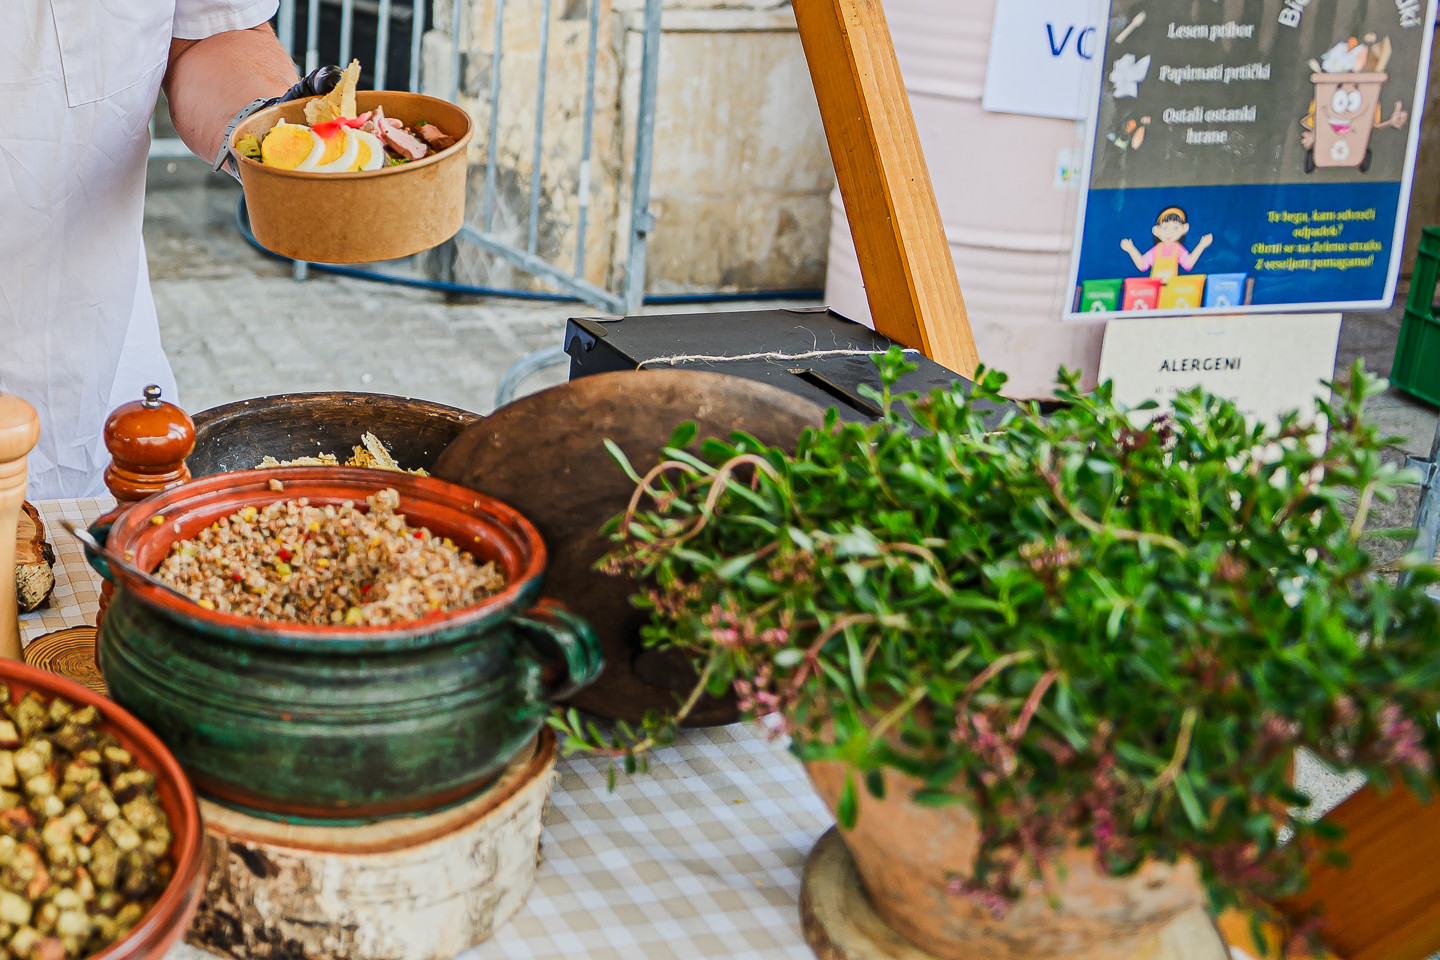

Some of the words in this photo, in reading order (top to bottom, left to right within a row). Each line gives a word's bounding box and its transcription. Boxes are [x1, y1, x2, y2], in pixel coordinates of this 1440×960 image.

[1167, 22, 1209, 39] Lesen
[1209, 21, 1255, 42] pribor
[1159, 64, 1223, 85] Papirnati
[1163, 105, 1204, 123] Ostali
[1204, 105, 1257, 123] ostanki
[1186, 127, 1228, 144] hrane
[1159, 357, 1241, 372] ALERGENI
